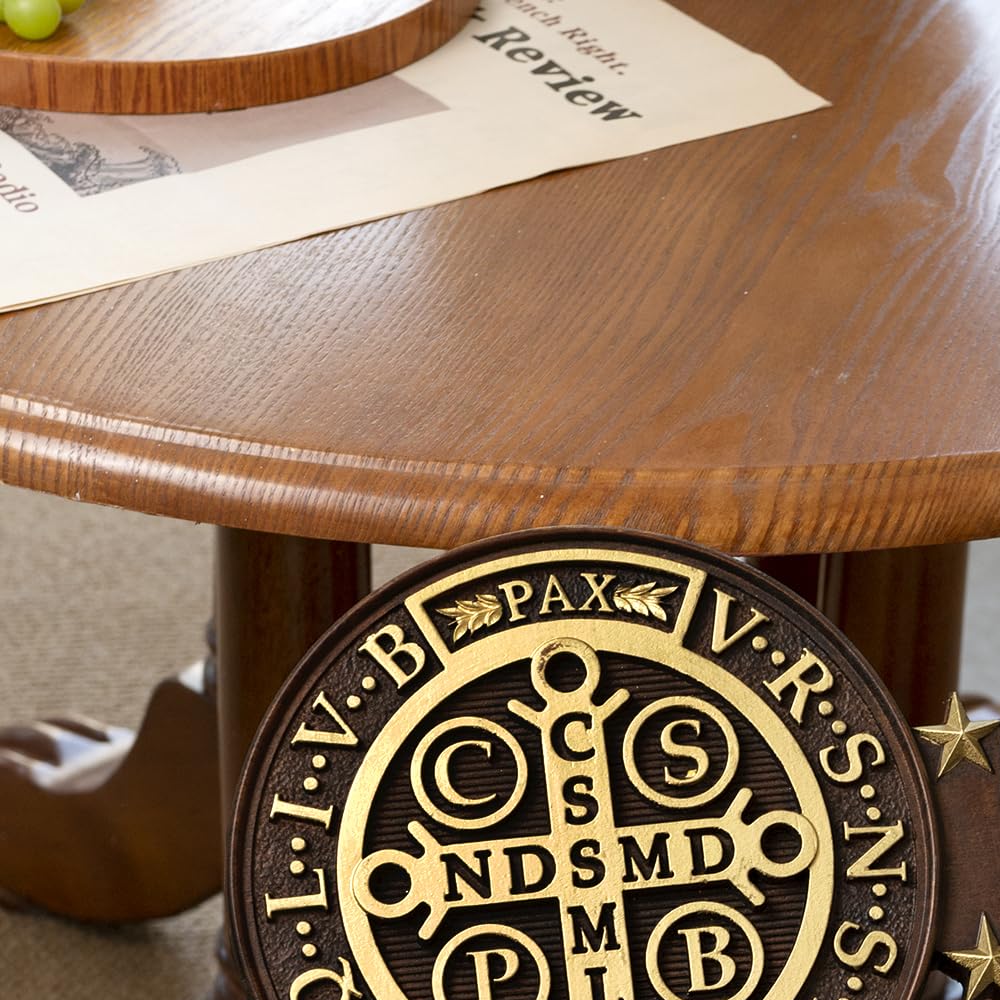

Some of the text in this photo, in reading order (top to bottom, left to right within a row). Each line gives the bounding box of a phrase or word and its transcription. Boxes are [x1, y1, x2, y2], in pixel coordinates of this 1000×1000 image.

[505, 0, 562, 27] nch
[558, 27, 629, 76] Right.
[472, 25, 644, 122] Review
[0, 173, 39, 213] dio
[498, 572, 616, 622] PAX
[434, 739, 497, 807] C
[660, 719, 709, 786] S
[677, 926, 737, 992] B
